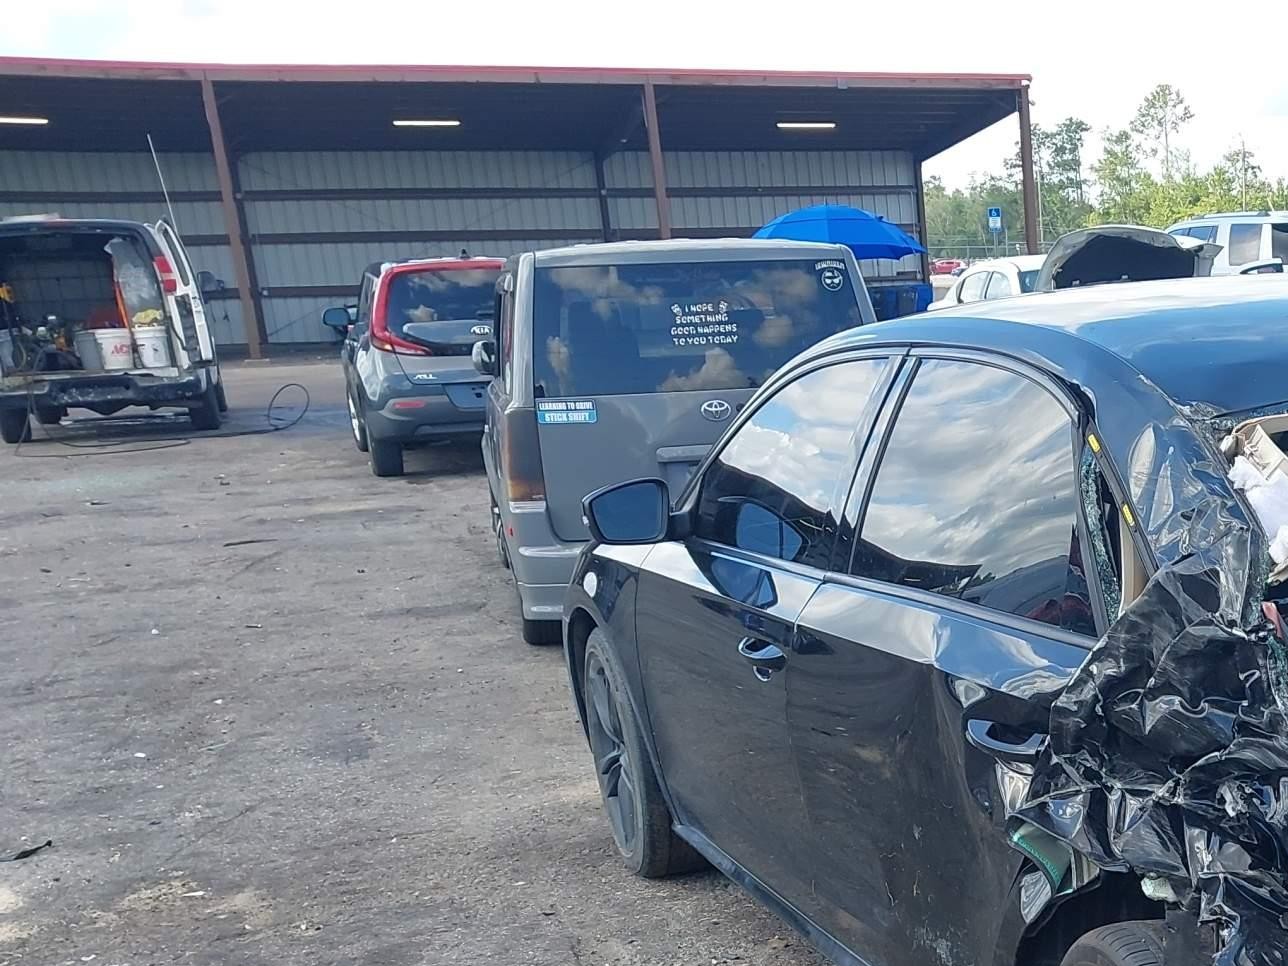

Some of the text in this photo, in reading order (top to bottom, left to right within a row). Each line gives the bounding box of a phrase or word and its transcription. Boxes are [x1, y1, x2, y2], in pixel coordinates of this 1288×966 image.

[690, 303, 714, 312] HOPE
[675, 313, 729, 324] SOMETHING
[670, 323, 737, 335] GOOD HAPPENS
[673, 335, 738, 346] TO YOU TODAY
[544, 412, 589, 422] STICK SHIFT
